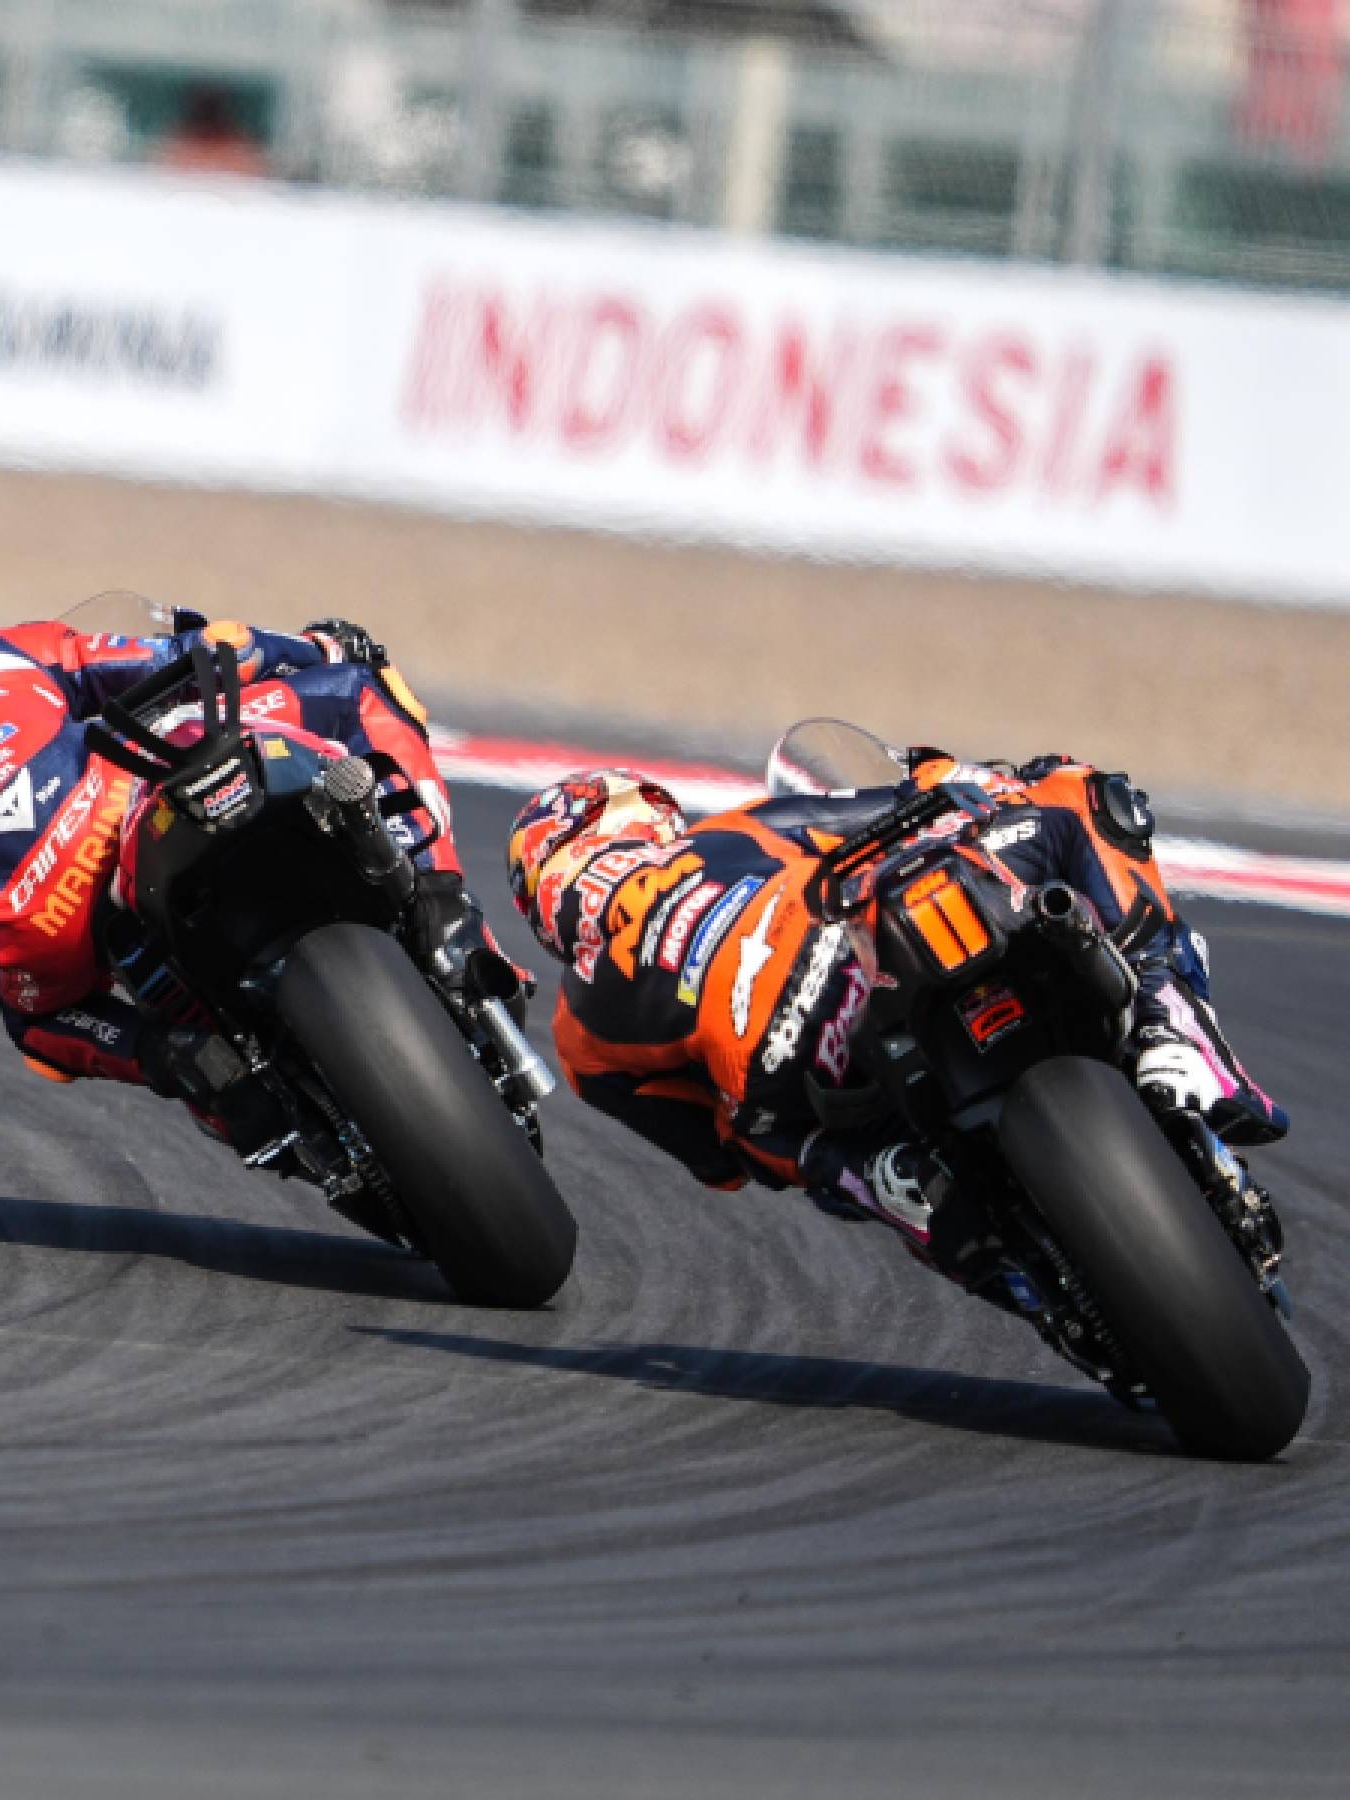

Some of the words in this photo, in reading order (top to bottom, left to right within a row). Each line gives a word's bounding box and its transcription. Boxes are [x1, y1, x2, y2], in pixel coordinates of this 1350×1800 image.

[404, 269, 1178, 513] INDONESIA
[30, 779, 130, 936] MARINI
[574, 874, 611, 984] Red
[662, 886, 721, 967] MOTUL
